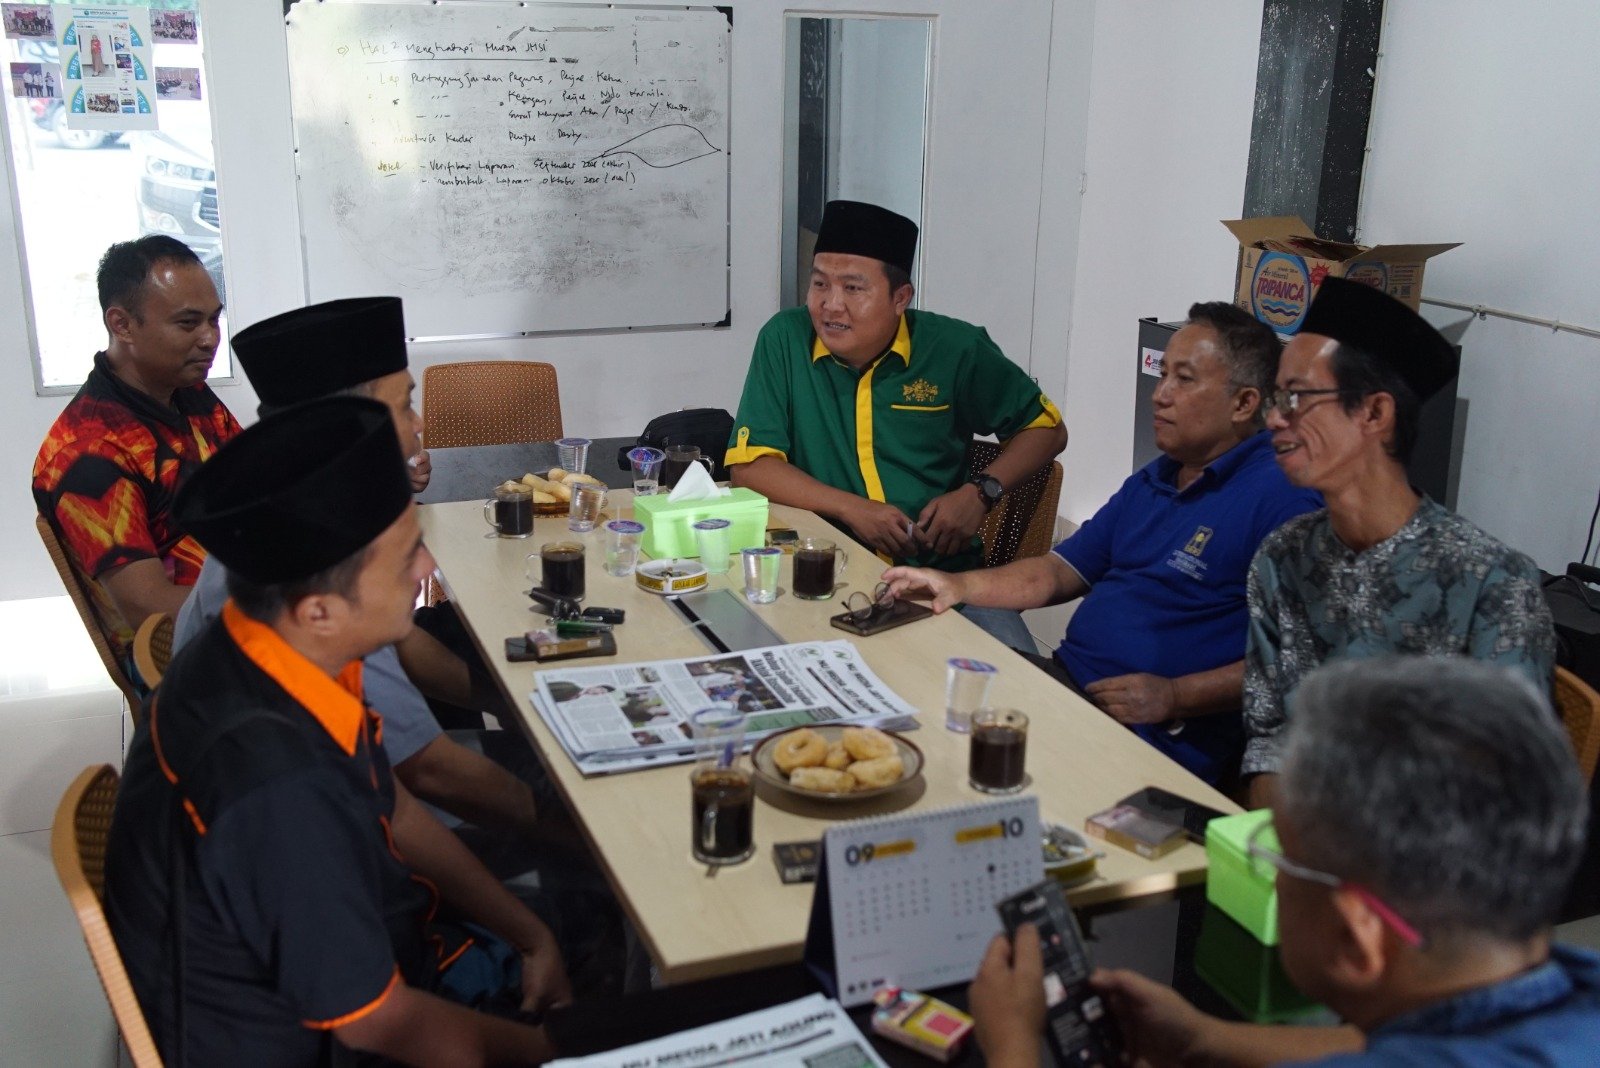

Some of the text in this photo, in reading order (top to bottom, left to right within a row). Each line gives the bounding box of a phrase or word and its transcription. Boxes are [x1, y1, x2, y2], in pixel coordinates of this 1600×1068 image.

[1256, 276, 1305, 301] TRIPANCA
[1000, 816, 1024, 839] 10
[844, 842, 876, 868] 09
[726, 1030, 765, 1050] JATI
[769, 1009, 837, 1038] AGUNG
